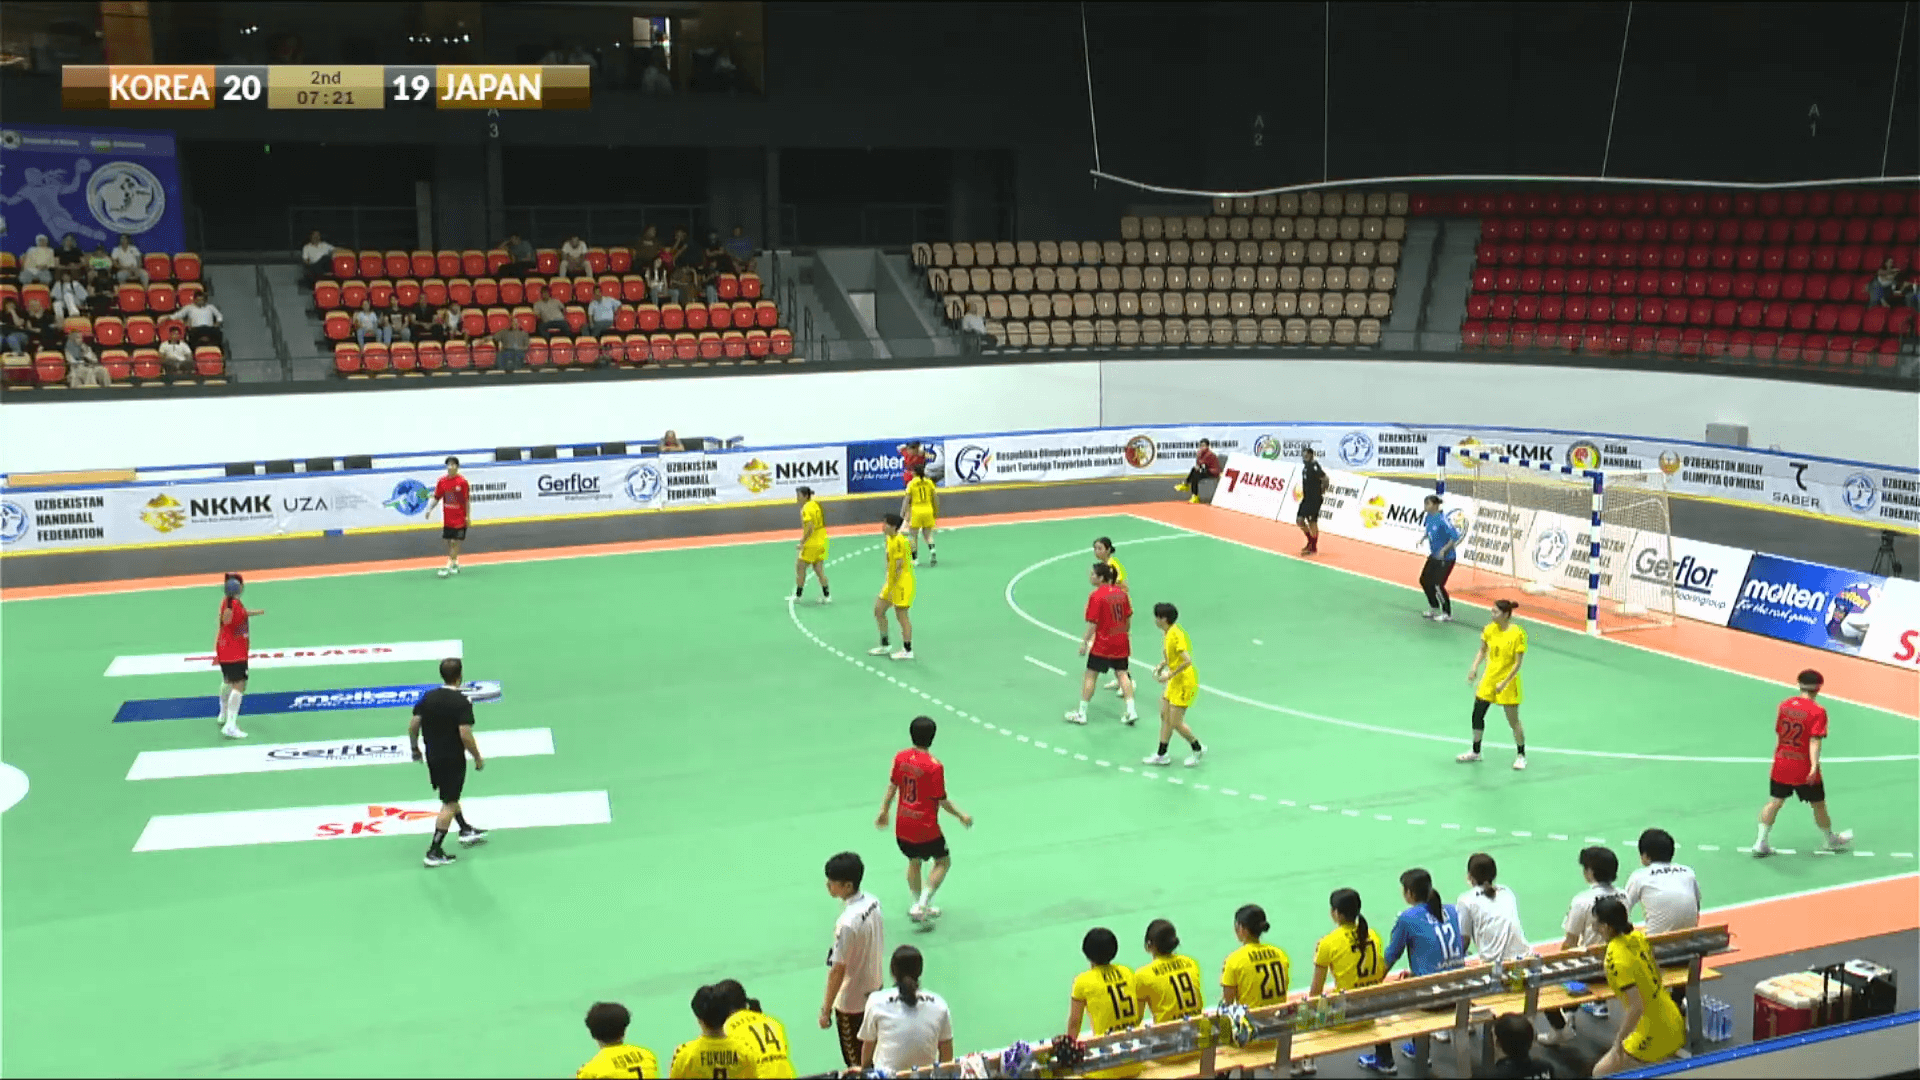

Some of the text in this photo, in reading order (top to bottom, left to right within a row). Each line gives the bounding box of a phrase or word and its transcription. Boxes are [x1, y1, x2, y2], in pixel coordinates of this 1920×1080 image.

[1808, 103, 1820, 117] A
[1254, 114, 1265, 128] A
[489, 122, 500, 138] 3
[1377, 432, 1428, 444] UZBEKISTAN
[1377, 446, 1419, 456] HANDBALL
[1604, 444, 1628, 455] ASIAN
[666, 460, 718, 473] UZBEKISTAN
[776, 459, 840, 479] NKMK
[1377, 458, 1425, 469] FEDERATION
[1603, 456, 1641, 469] HANDBALL
[1737, 462, 1764, 475] MILLIY
[538, 473, 600, 493] Gerflor
[667, 473, 709, 487] HANDBALL
[1240, 471, 1286, 491] ALKASS
[1682, 470, 1722, 486] OLIMPIYA
[667, 487, 717, 501] FEDERATION
[1772, 492, 1821, 509] SABER
[34, 496, 104, 511] UZBEKISTAN
[190, 494, 273, 517] NKMK
[283, 496, 329, 512] UZA
[35, 512, 94, 527] HANDBALL
[1386, 503, 1427, 527] NKM
[37, 527, 104, 542] FEDERATION
[1636, 548, 1719, 587] Gerflor
[1744, 579, 1826, 612] molten
[1893, 629, 1920, 664] S
[294, 690, 420, 706] molten
[1782, 720, 1803, 747] 22
[266, 744, 403, 761] Gerflor
[316, 820, 384, 837] SK
[1650, 866, 1688, 877] JAPAN
[1434, 922, 1461, 960] 12
[1255, 961, 1287, 1000] 20
[1169, 972, 1198, 1010] 19
[1107, 981, 1136, 1020] 15
[749, 1023, 781, 1054] 14
[700, 1050, 739, 1067] FUKUDA
